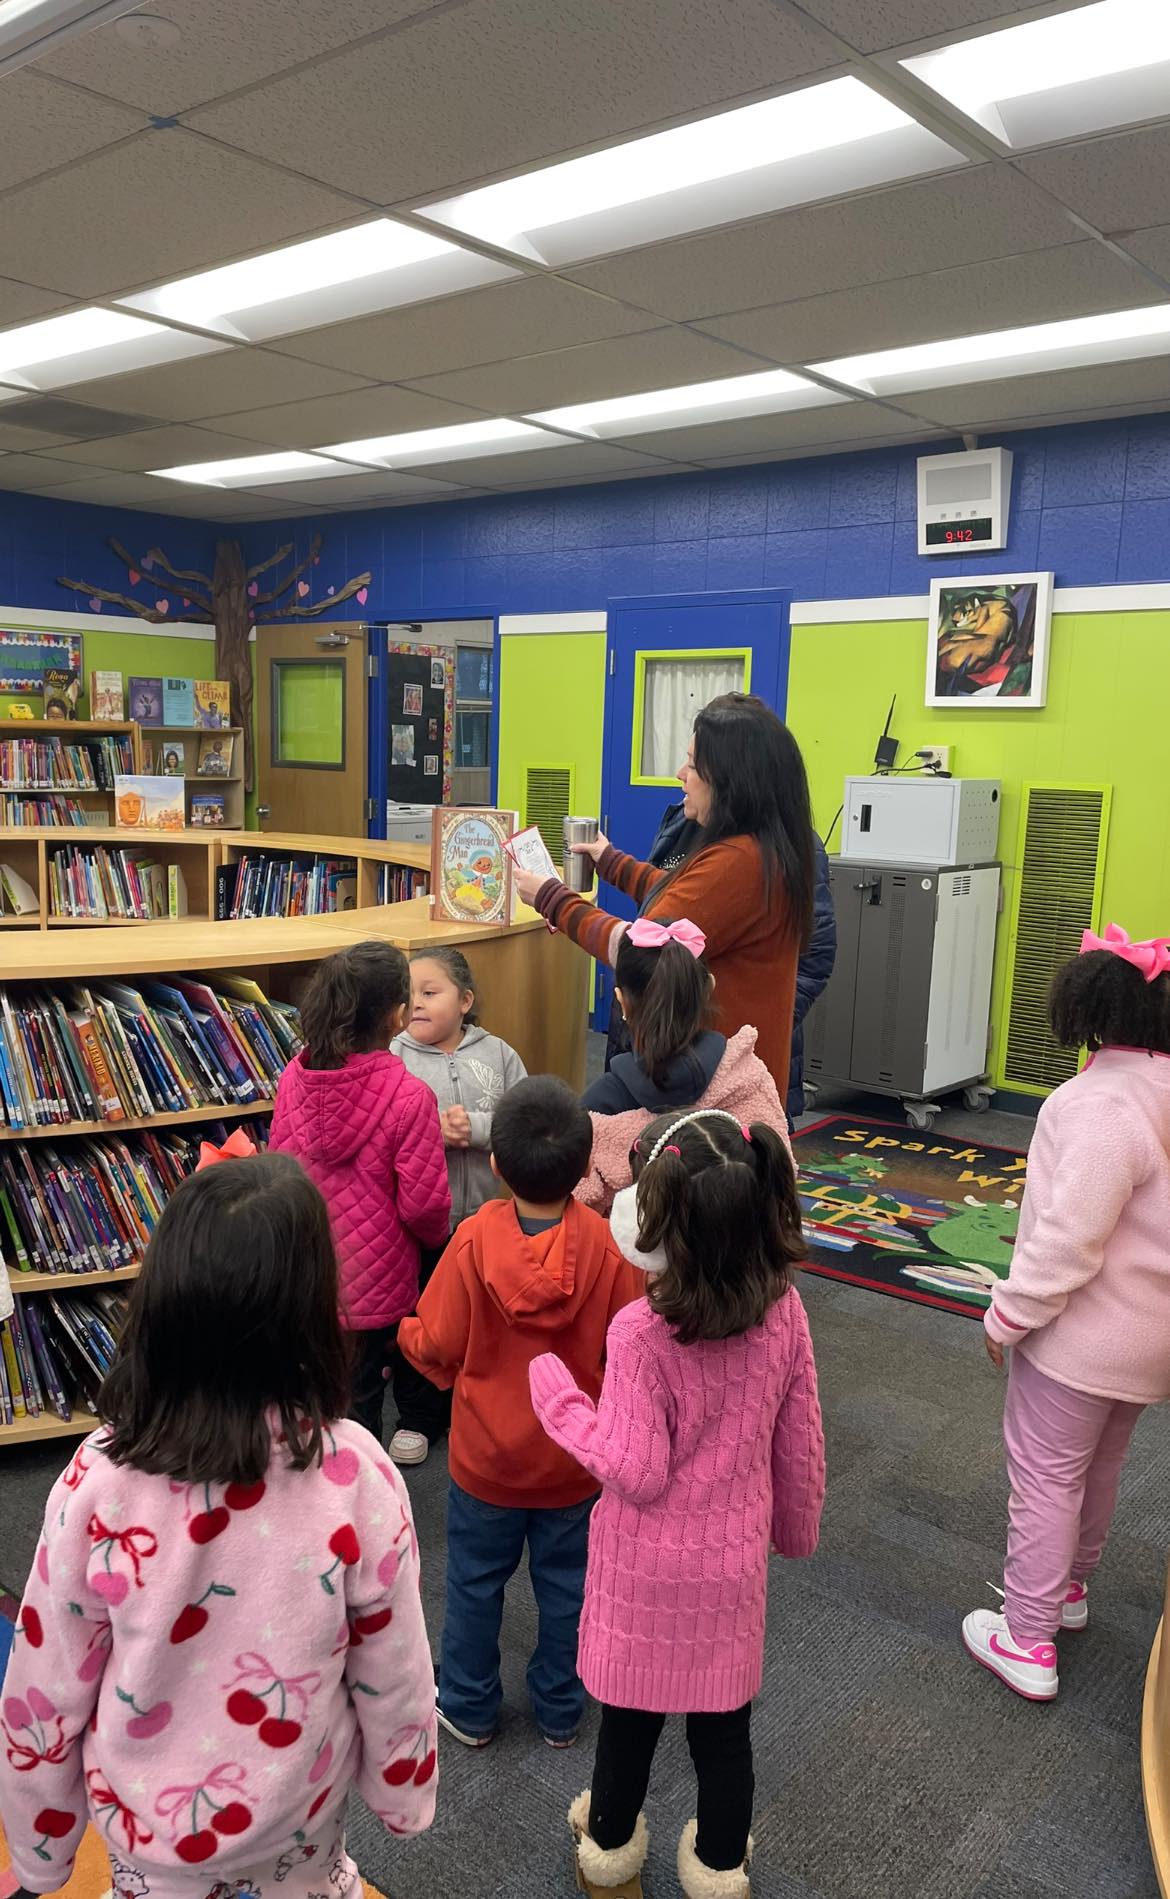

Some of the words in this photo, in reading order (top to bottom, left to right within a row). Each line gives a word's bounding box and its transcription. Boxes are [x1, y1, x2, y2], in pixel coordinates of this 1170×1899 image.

[945, 530, 973, 543] 9:42
[464, 824, 475, 833] The
[454, 831, 495, 849] Gingerbread
[447, 845, 468, 862] Man
[833, 1130, 986, 1163] Spark
[957, 1170, 1026, 1193] Wi
